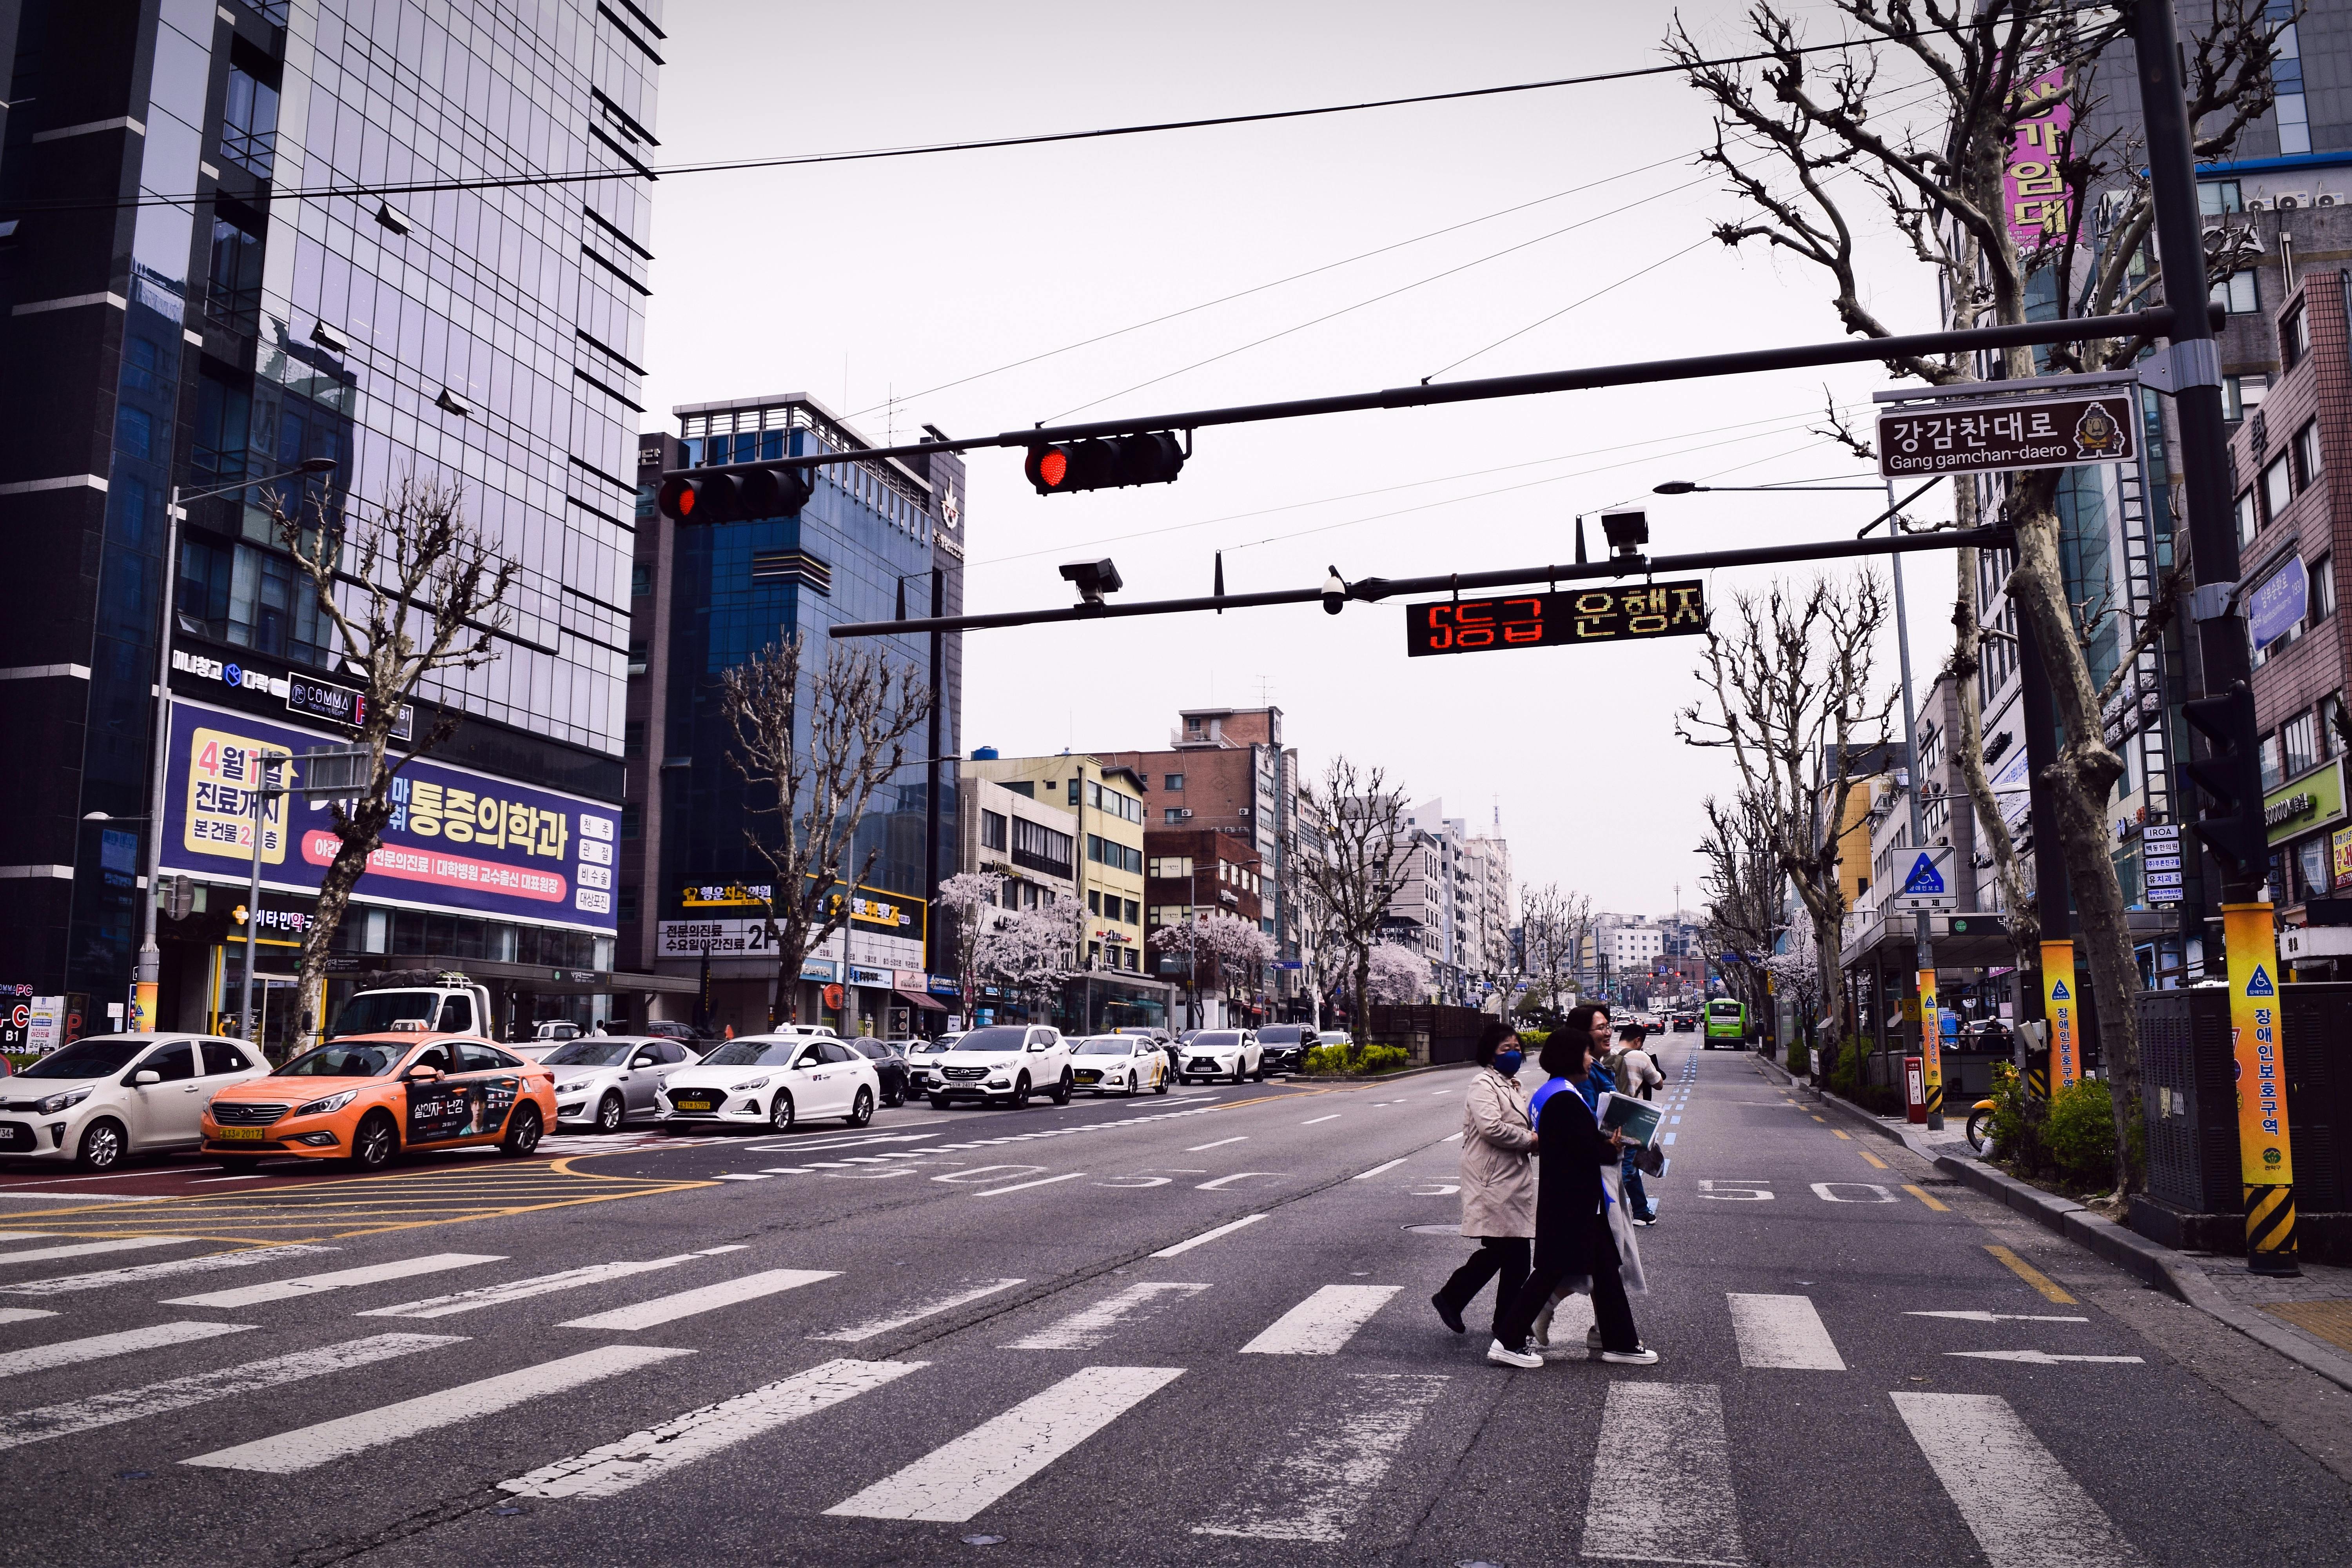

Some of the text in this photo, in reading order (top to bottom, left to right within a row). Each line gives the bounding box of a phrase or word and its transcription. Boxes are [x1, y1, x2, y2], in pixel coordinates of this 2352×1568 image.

[1894, 412, 2058, 452] 강감찬대로
[1890, 444, 2067, 470] Gang gamchan-daero
[2261, 573, 2288, 608] 남부순환로
[1428, 598, 1544, 648] 5등급
[172, 650, 269, 693] 미니창고 다락
[308, 686, 348, 710] COMMA
[399, 709, 409, 721] B1
[194, 819, 208, 838] 본
[211, 822, 237, 843] 건물
[409, 780, 568, 861] 통증의학과
[2150, 828, 2171, 837] IROA
[2146, 843, 2178, 852] 백동한의원
[373, 850, 429, 873] 전문의진료
[437, 861, 478, 882] 대학병원
[480, 869, 519, 888] 교수출신
[521, 874, 558, 894] 대표원장
[580, 892, 607, 909] 대상포진
[666, 924, 722, 938] 전문의진료
[666, 938, 745, 951] 수요일야간진료
[16, 984, 33, 996] PC
[6, 1030, 18, 1042] B1
[1927, 1013, 1937, 1065] 장애인보호구역
[2057, 1007, 2074, 1088] 장애인보호구역
[2254, 1008, 2278, 1136] 장애인보호구역
[0, 1129, 10, 1137] 34
